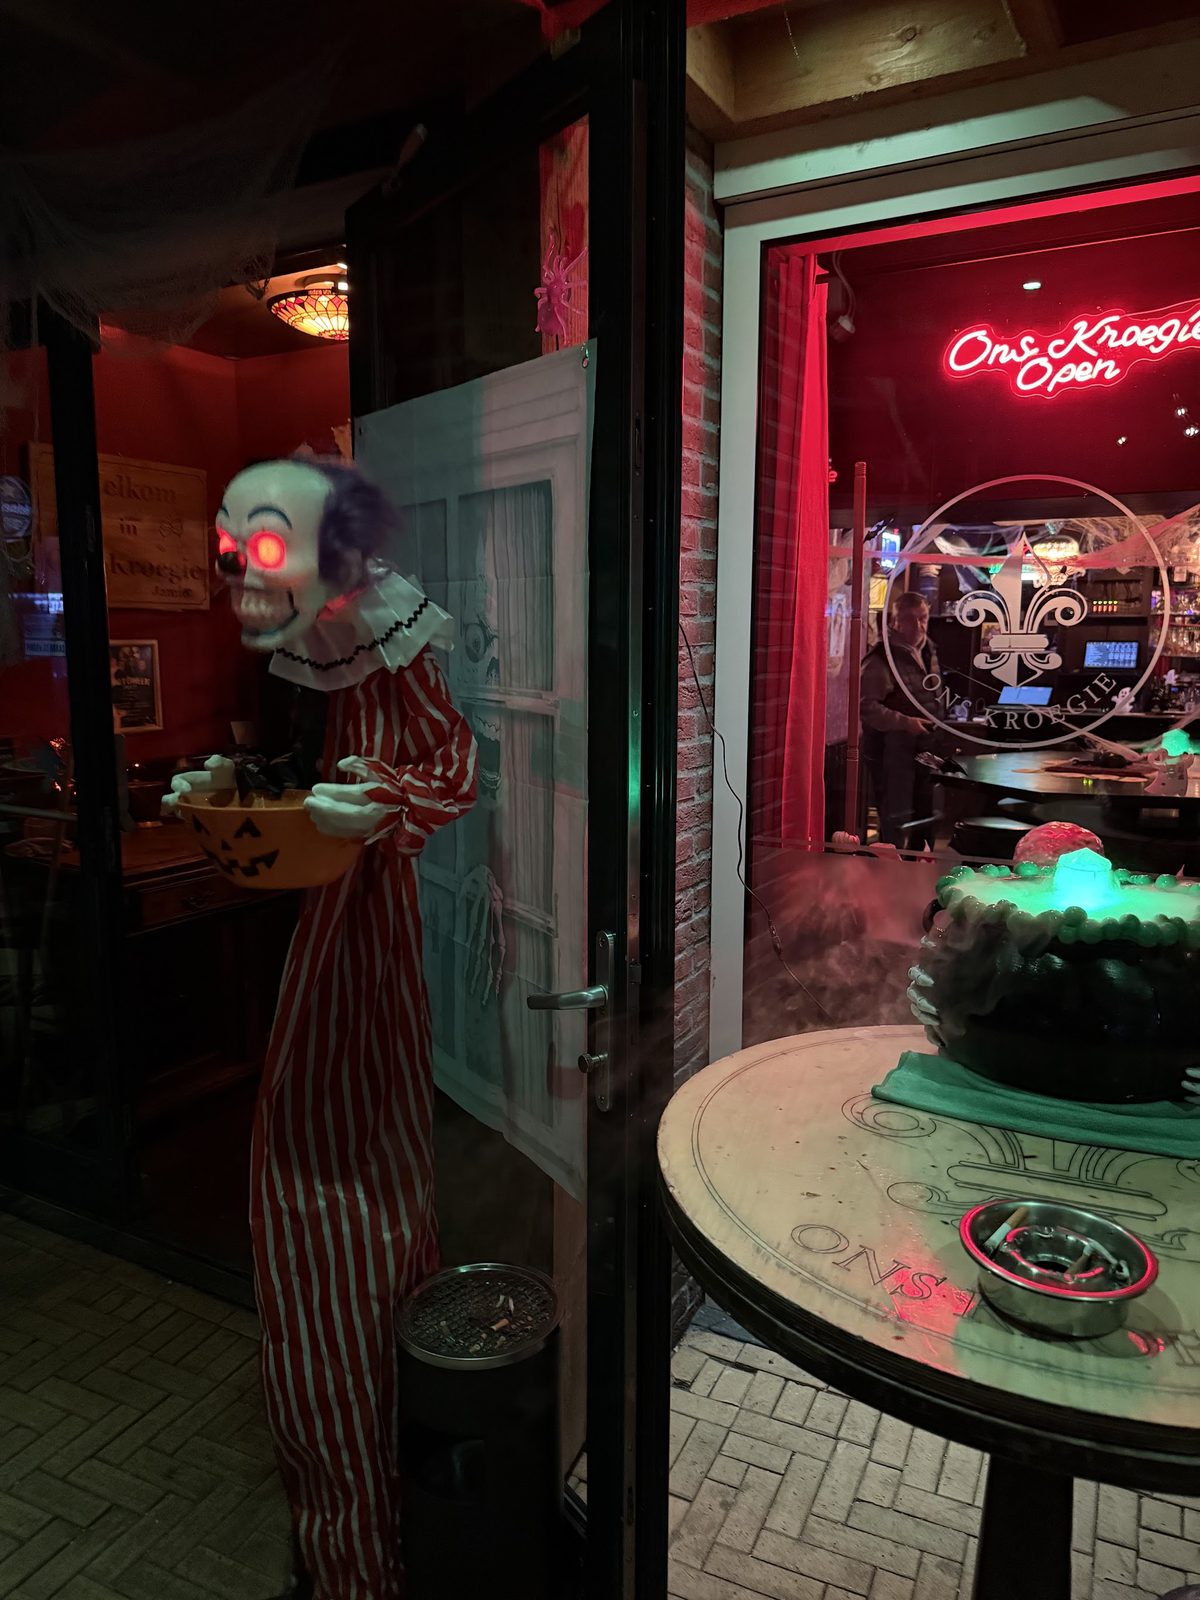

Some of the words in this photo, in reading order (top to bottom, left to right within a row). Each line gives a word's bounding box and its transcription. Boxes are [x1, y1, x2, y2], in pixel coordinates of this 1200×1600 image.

[949, 329, 1040, 372] Ons
[1016, 356, 1121, 393] Open
[104, 474, 177, 504] elkom
[922, 673, 973, 719] ONS
[982, 672, 1117, 730] KROEGIE
[790, 1223, 948, 1301] ONS
